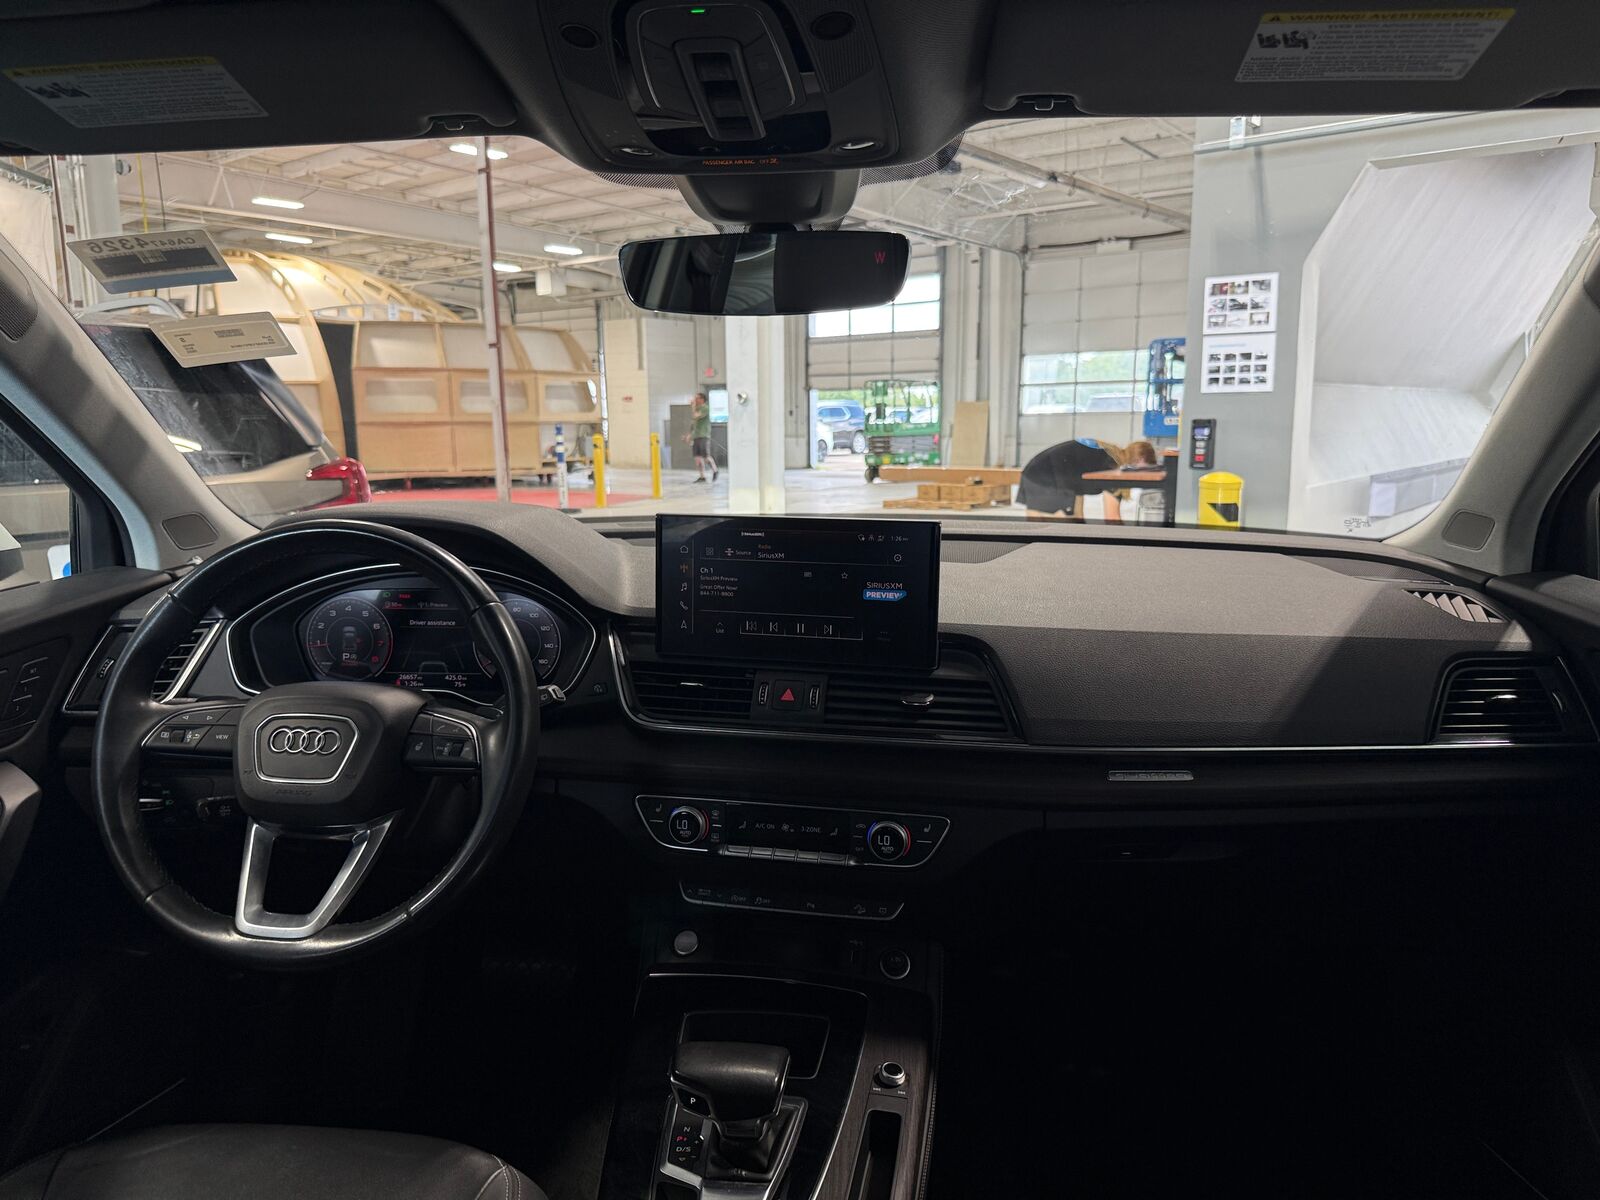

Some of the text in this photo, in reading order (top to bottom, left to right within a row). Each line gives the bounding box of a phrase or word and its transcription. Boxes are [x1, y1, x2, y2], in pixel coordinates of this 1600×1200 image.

[873, 250, 887, 264] W
[757, 551, 785, 560] SiriusXM
[866, 581, 903, 590] SIRIUSXM
[410, 619, 427, 627] Driver
[342, 653, 350, 661] P
[676, 819, 689, 830] LO
[877, 834, 891, 846] LO
